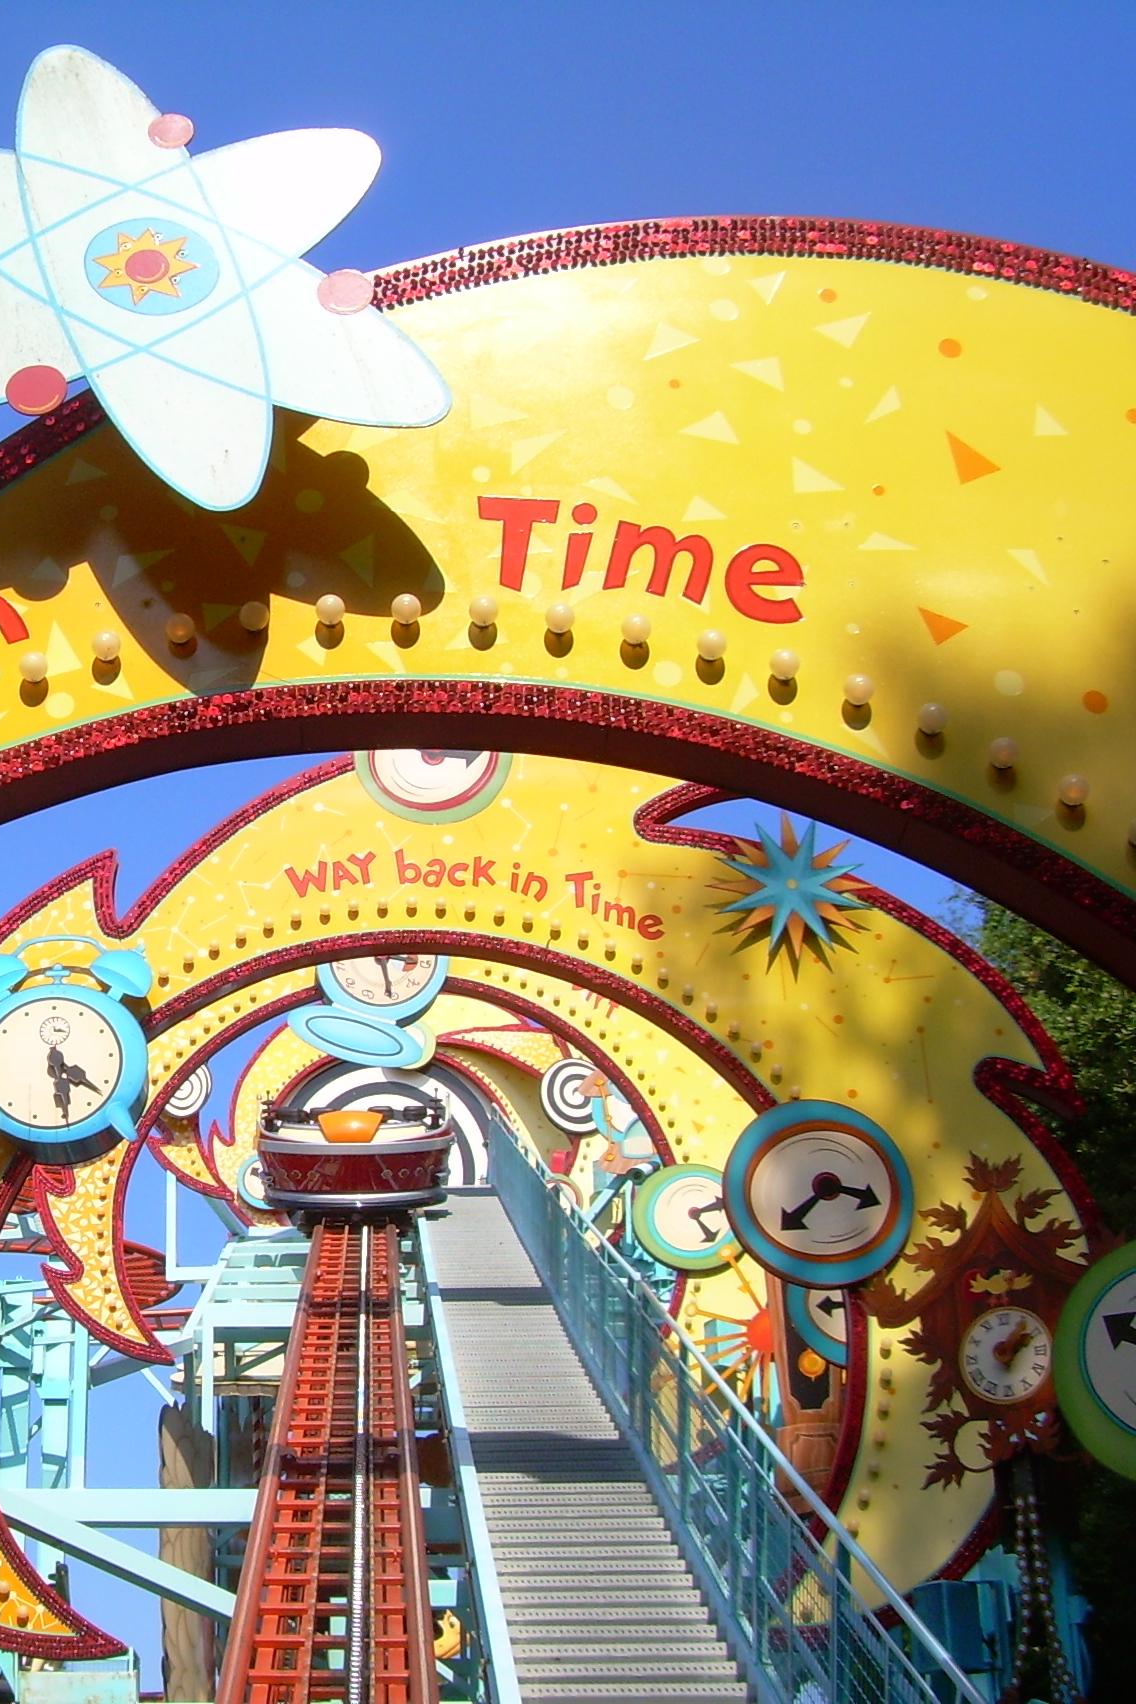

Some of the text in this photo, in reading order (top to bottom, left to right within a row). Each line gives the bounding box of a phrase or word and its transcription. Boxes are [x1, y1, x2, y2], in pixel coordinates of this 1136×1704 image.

[476, 495, 806, 625] Time
[284, 848, 666, 941] WAY back in Time
